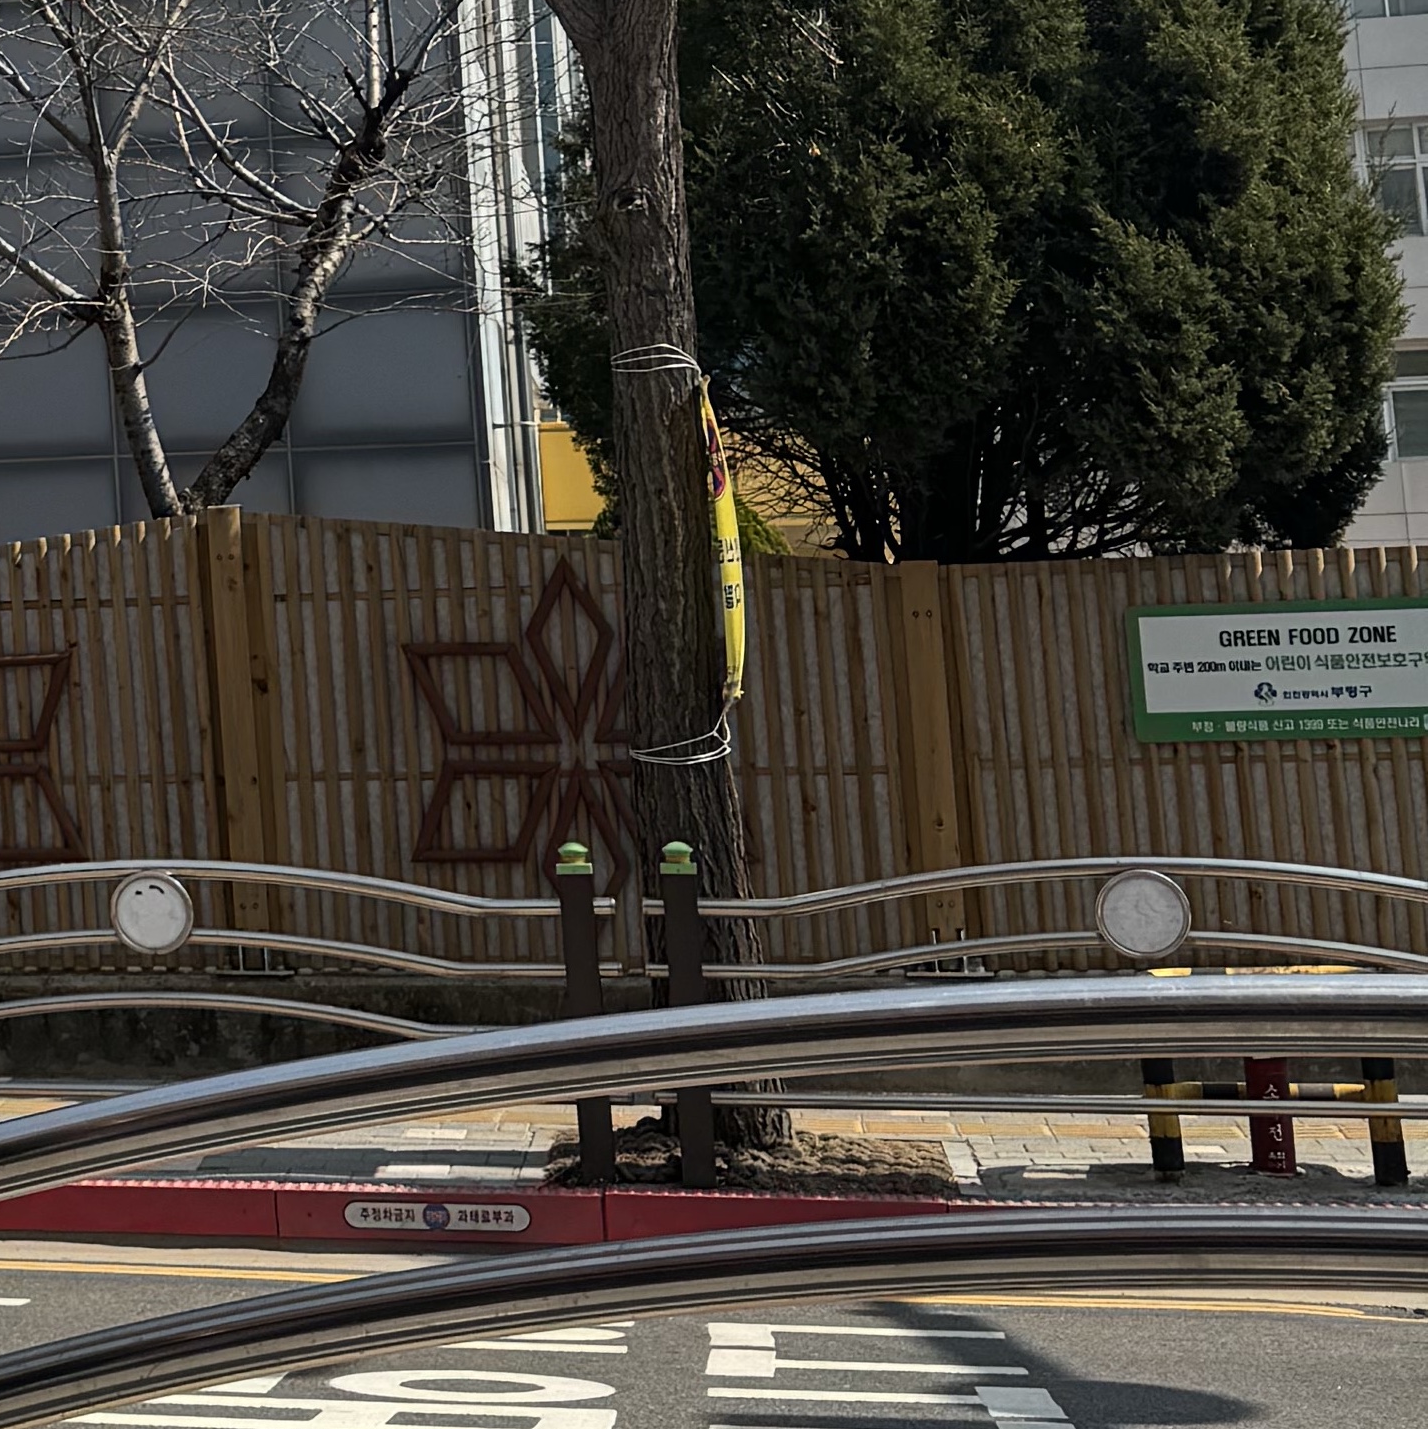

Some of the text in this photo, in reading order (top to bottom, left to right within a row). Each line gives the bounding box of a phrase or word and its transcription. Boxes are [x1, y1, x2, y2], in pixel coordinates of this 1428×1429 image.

[1219, 625, 1397, 647] GREEN FOOD ZONE
[1148, 652, 1428, 673] 학교 주변 200m 이내는 어린이 식품안전보호구
[1331, 684, 1372, 699] 부평구
[1273, 719, 1294, 731] 신고
[1327, 718, 1349, 730] 또는
[1262, 1083, 1283, 1142] 소전
[360, 1207, 515, 1225] 주정차금지 과태료부과
